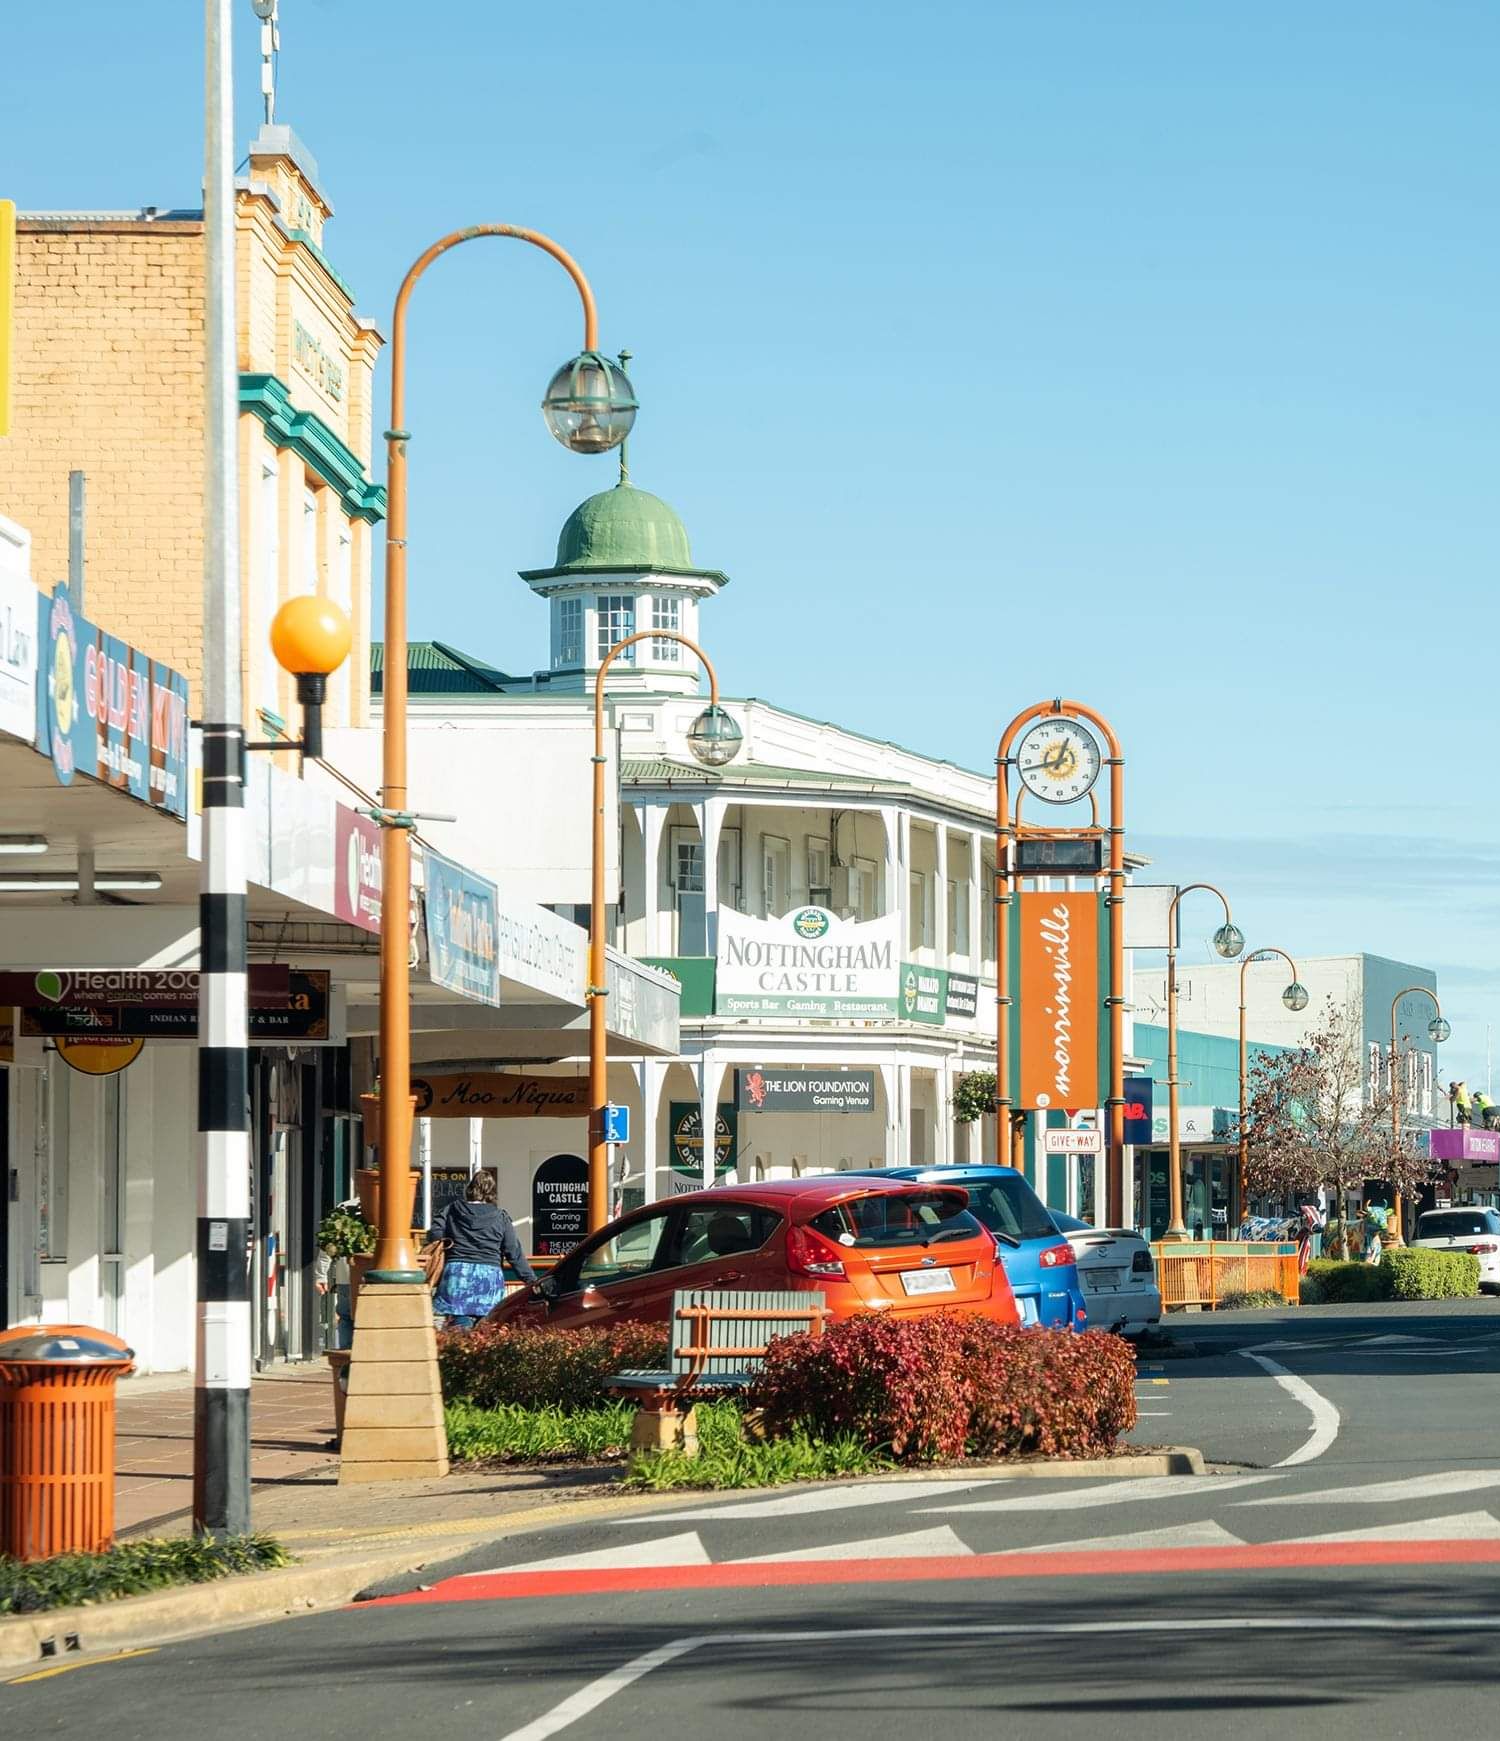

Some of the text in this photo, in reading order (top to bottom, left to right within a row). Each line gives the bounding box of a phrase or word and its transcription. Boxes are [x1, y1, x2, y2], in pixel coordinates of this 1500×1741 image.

[84, 643, 149, 750] GOLDEN
[1082, 742, 1090, 750] 2
[725, 935, 892, 970] NOTTINGHAM
[75, 972, 150, 989] Health
[758, 972, 858, 992] CASTLE
[73, 990, 104, 1001] where
[107, 991, 143, 1002] caring
[144, 992, 177, 1000] comes
[1039, 902, 1073, 1098] morrinsville
[727, 998, 888, 1013] Sports Bar Gaming Restaurant
[149, 1014, 187, 1023] INDIAN
[268, 1015, 289, 1024] BAR
[765, 1080, 869, 1093] THE LION FOUNDATION
[441, 1082, 576, 1114] Moo Nique
[813, 1096, 869, 1107] Gaming Venue
[1051, 1135, 1095, 1147] GIVE WAY
[549, 1193, 583, 1204] CASTLE
[550, 1212, 581, 1222] Gaming
[551, 1222, 580, 1232] Lounge
